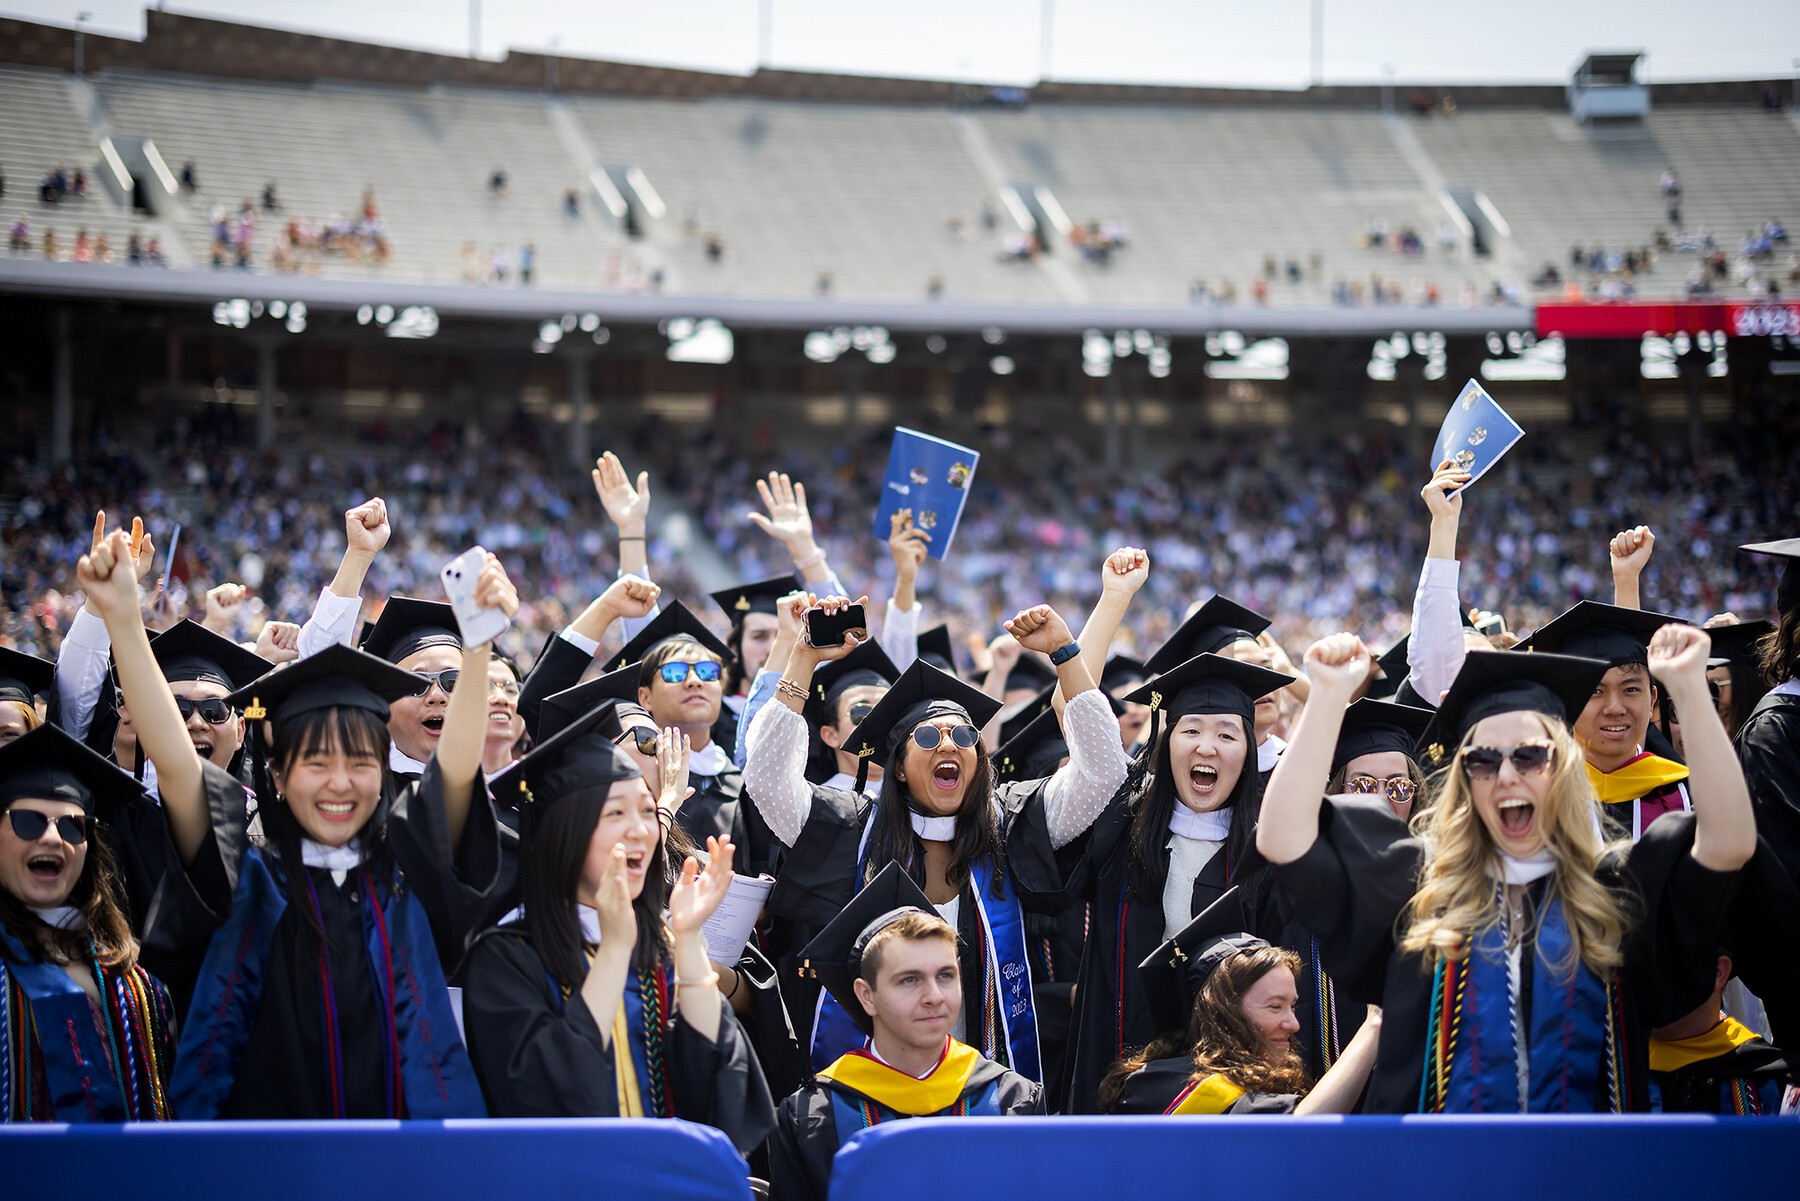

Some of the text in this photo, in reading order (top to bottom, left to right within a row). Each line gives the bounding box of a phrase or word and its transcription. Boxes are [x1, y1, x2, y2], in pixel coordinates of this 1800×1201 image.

[1732, 304, 1800, 336] 2023
[1002, 962, 1025, 980] Class
[1011, 978, 1023, 998] of
[1011, 998, 1027, 1018] 2023
